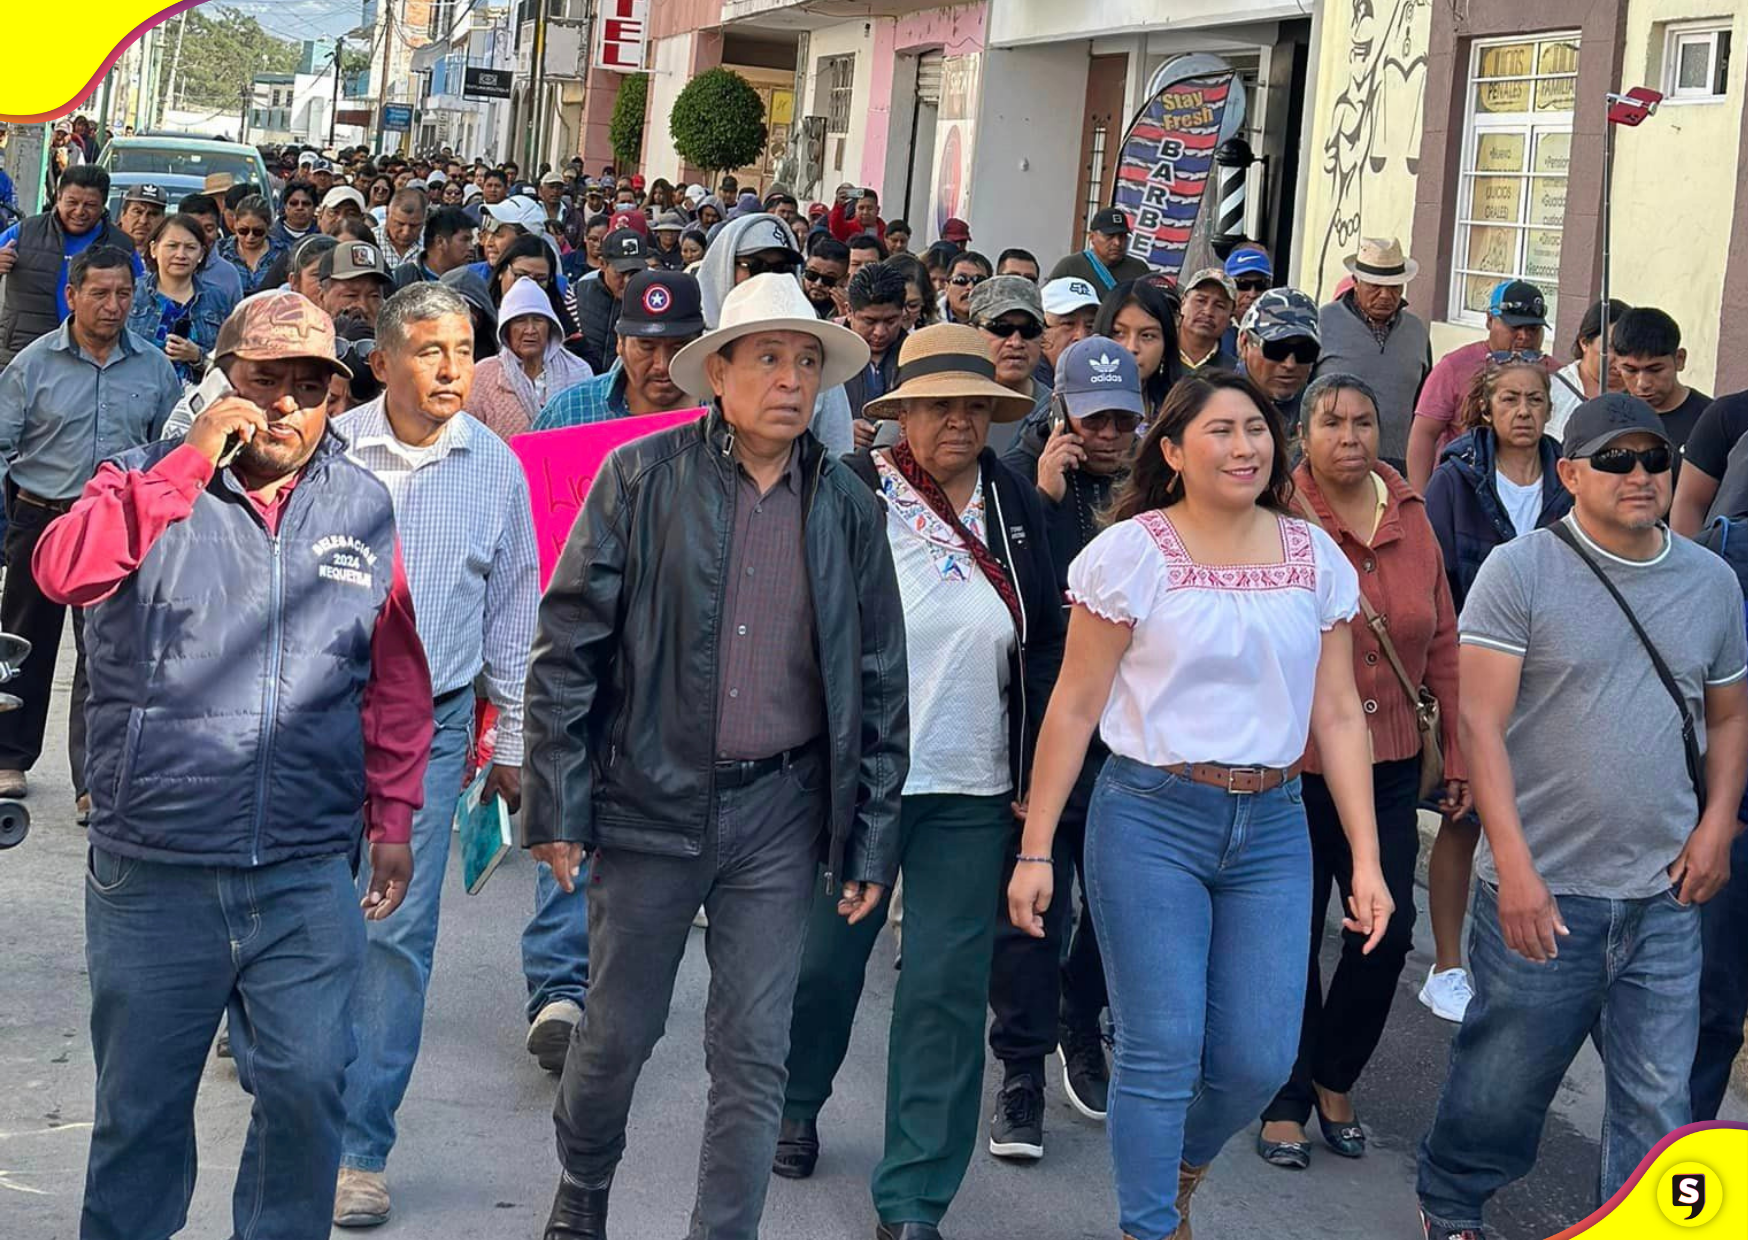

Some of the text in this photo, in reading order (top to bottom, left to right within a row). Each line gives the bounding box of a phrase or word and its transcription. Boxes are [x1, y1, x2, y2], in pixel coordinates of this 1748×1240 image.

[1161, 91, 1204, 111] Stay
[1162, 107, 1215, 131] Fresh
[1090, 374, 1122, 383] adidas
[333, 552, 361, 570] 2024
